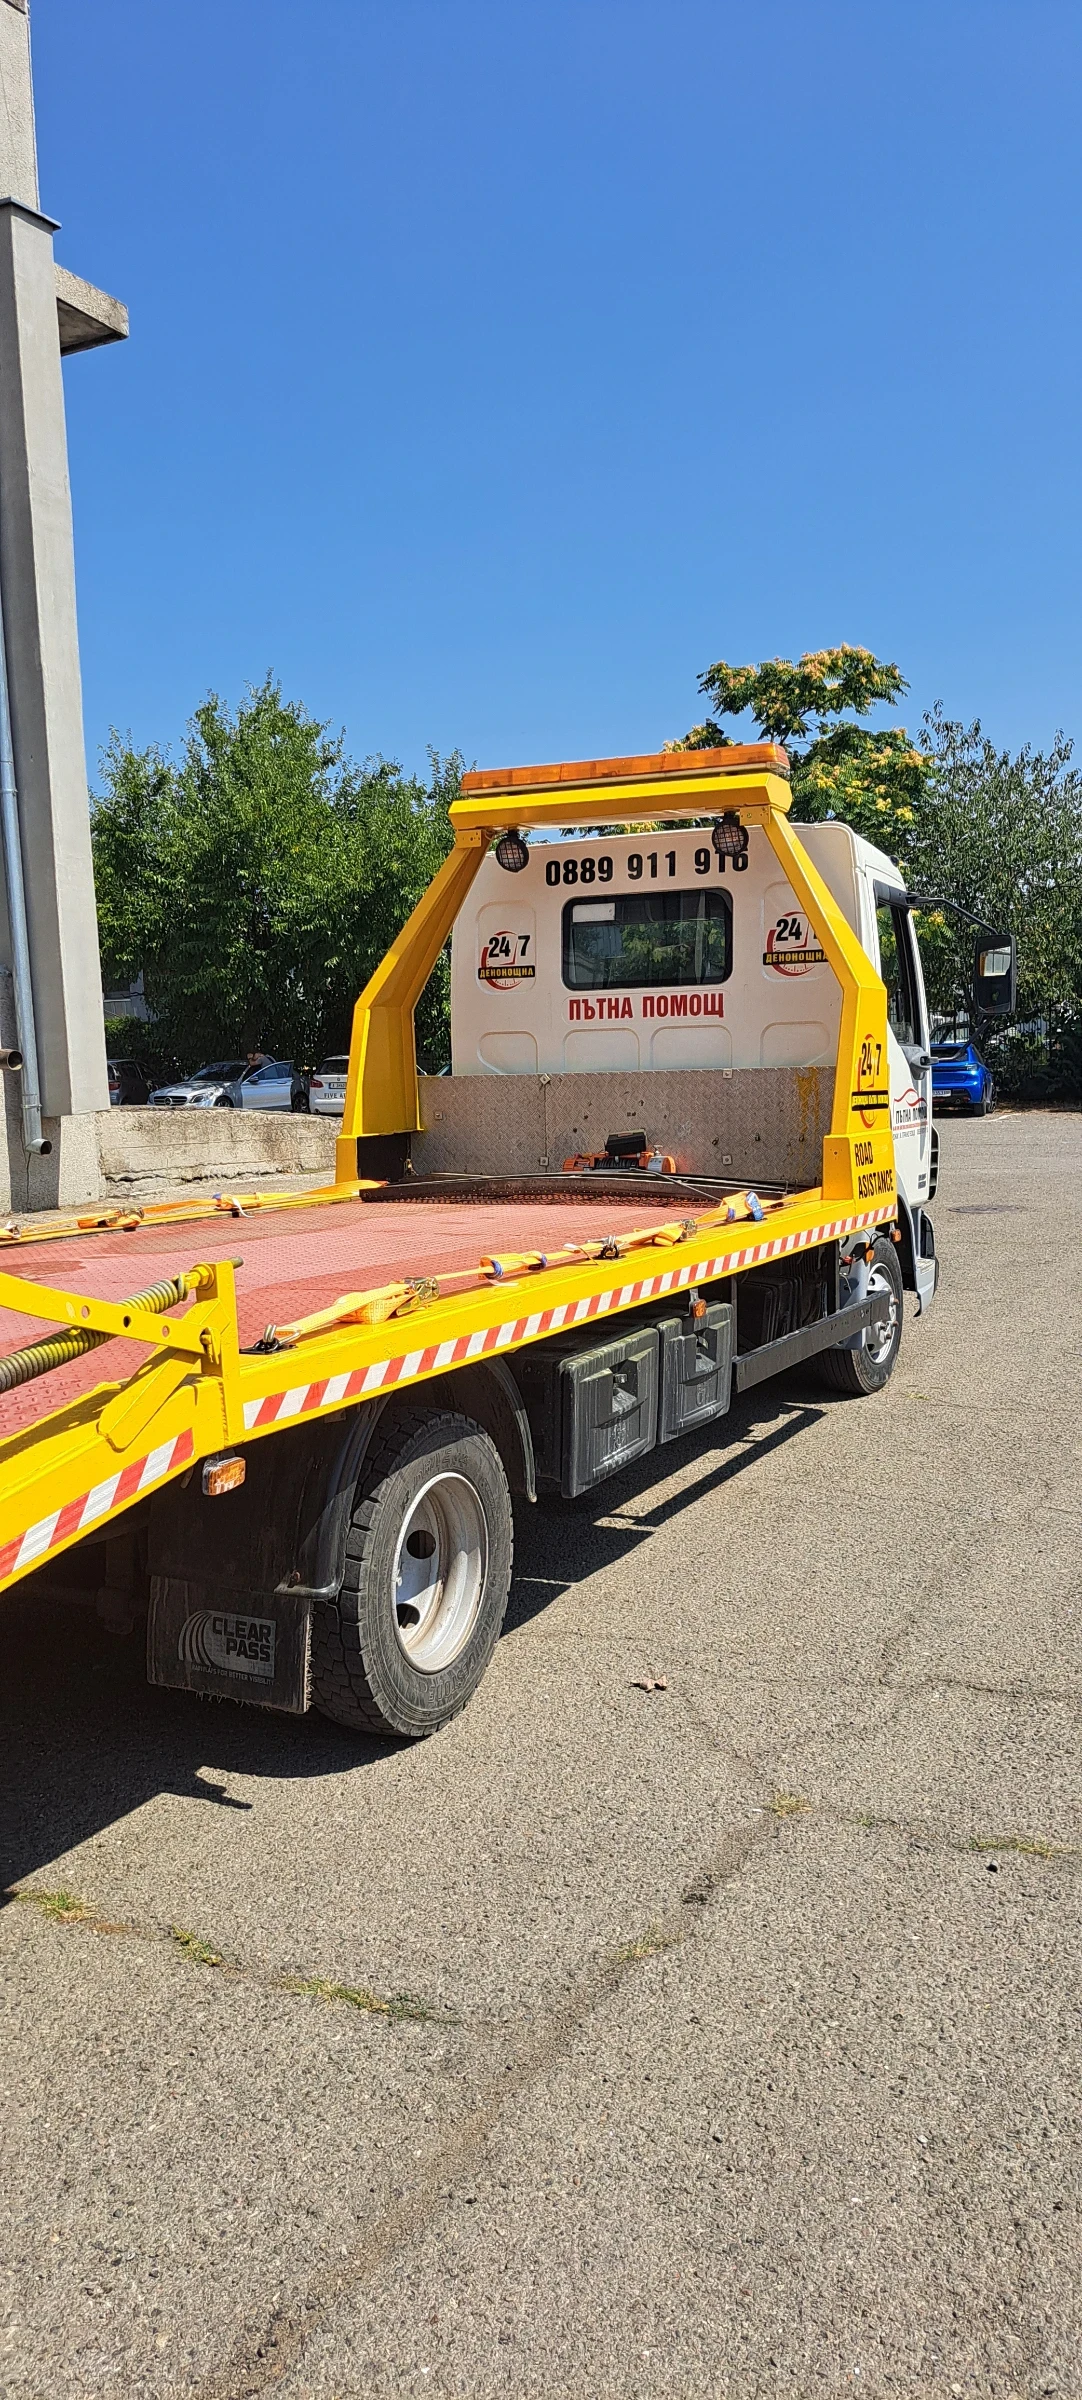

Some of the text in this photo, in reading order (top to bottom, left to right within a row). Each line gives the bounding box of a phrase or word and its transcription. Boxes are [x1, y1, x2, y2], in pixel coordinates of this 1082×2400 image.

[545, 856, 613, 887] 0889
[627, 850, 676, 880] 911
[775, 917, 802, 942] 24
[488, 935, 531, 958] 24 7
[479, 967, 534, 979] ДЕНОНОЩНА
[568, 992, 725, 1021] ПЪТНА ПОМОЩ
[861, 1041, 882, 1076] 24 7
[854, 1140, 873, 1168] ROAD
[858, 1168, 894, 1200] ASISTANCE
[212, 1616, 271, 1644] CLEAR
[225, 1637, 271, 1662] PASS
